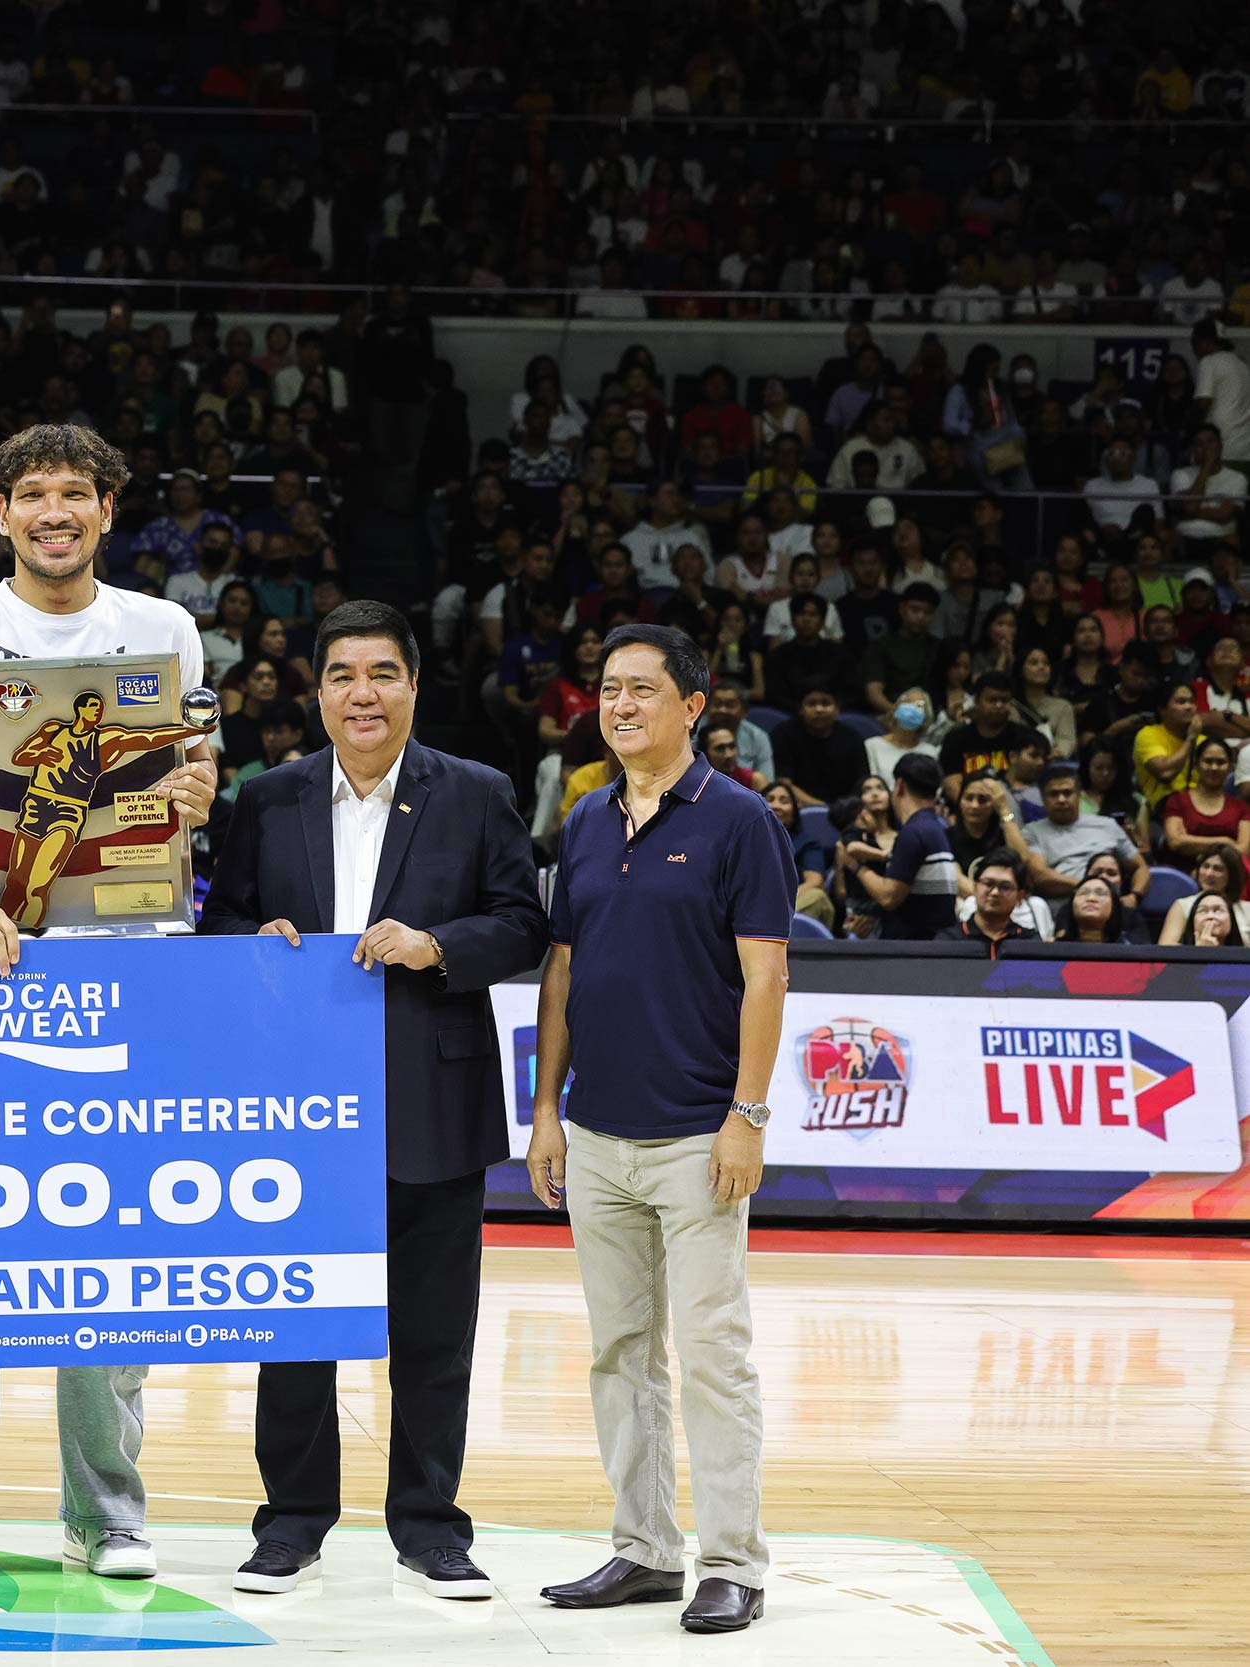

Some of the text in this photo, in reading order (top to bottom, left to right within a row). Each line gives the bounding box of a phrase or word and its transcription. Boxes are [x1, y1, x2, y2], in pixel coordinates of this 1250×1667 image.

[118, 680, 157, 689] POCARI
[118, 687, 154, 696] SWEAT
[117, 795, 136, 803] BEST
[127, 803, 156, 812] OF THE
[118, 813, 165, 823] CONFERENCE
[18, 972, 48, 981] DRINK
[986, 1029, 1118, 1057] PILIPINAS
[807, 1040, 904, 1082] PBA
[984, 1062, 1130, 1126] LIVE
[42, 1095, 360, 1136] CONFERENCE
[800, 1086, 908, 1131] RUSH
[131, 1261, 315, 1307] PESOS
[99, 1328, 182, 1344] PBAOfficial
[210, 1328, 240, 1341] PBA
[243, 1327, 275, 1344] App
